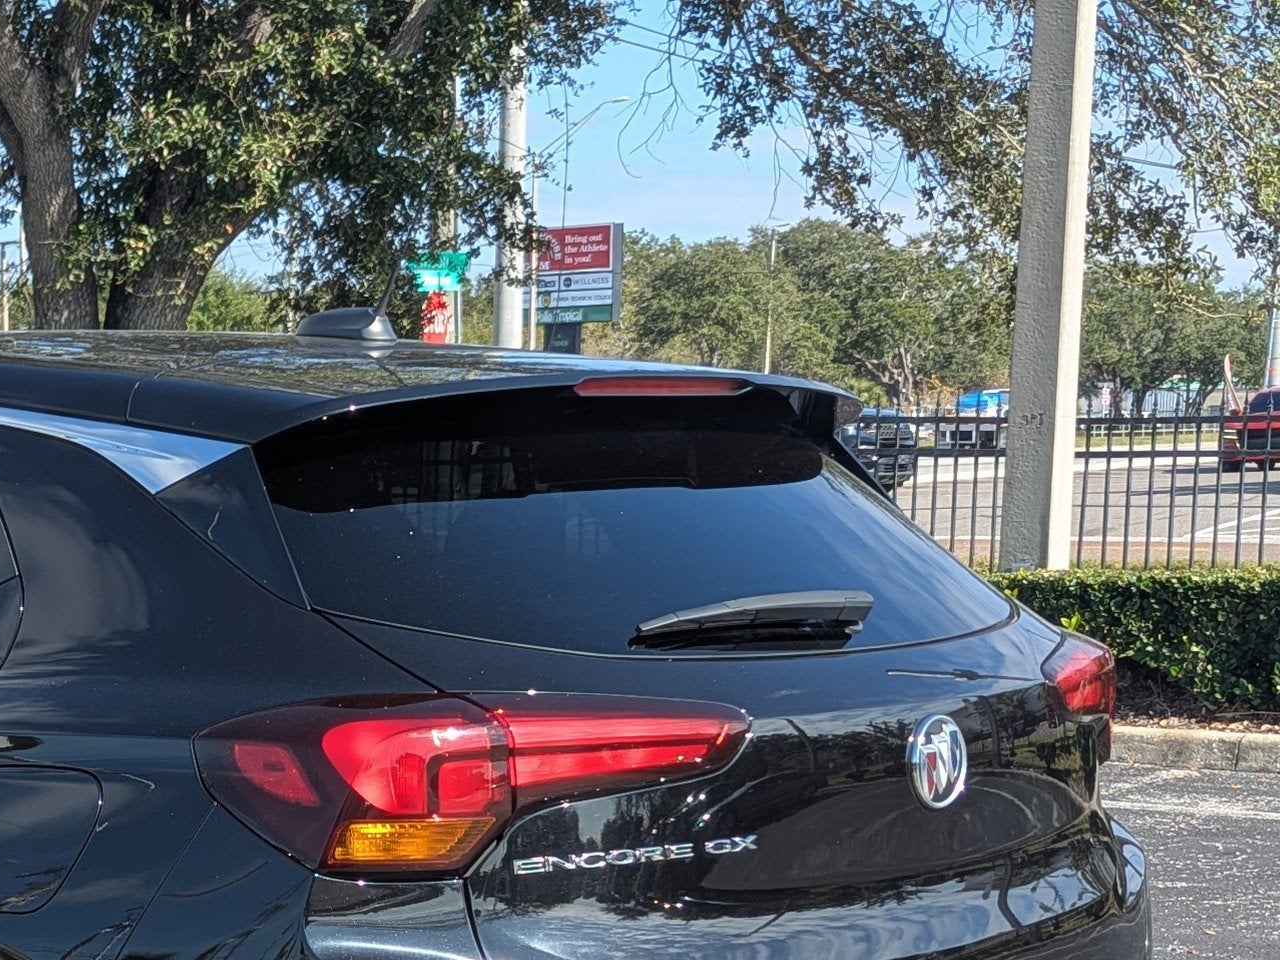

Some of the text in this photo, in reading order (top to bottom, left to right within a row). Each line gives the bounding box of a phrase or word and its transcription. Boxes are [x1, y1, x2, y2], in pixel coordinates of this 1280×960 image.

[564, 233, 603, 245] Bring out
[564, 243, 608, 254] the Athlete
[564, 254, 592, 266] in you!
[572, 276, 610, 286] WELLNESS
[513, 834, 758, 875] ENCORE GX
